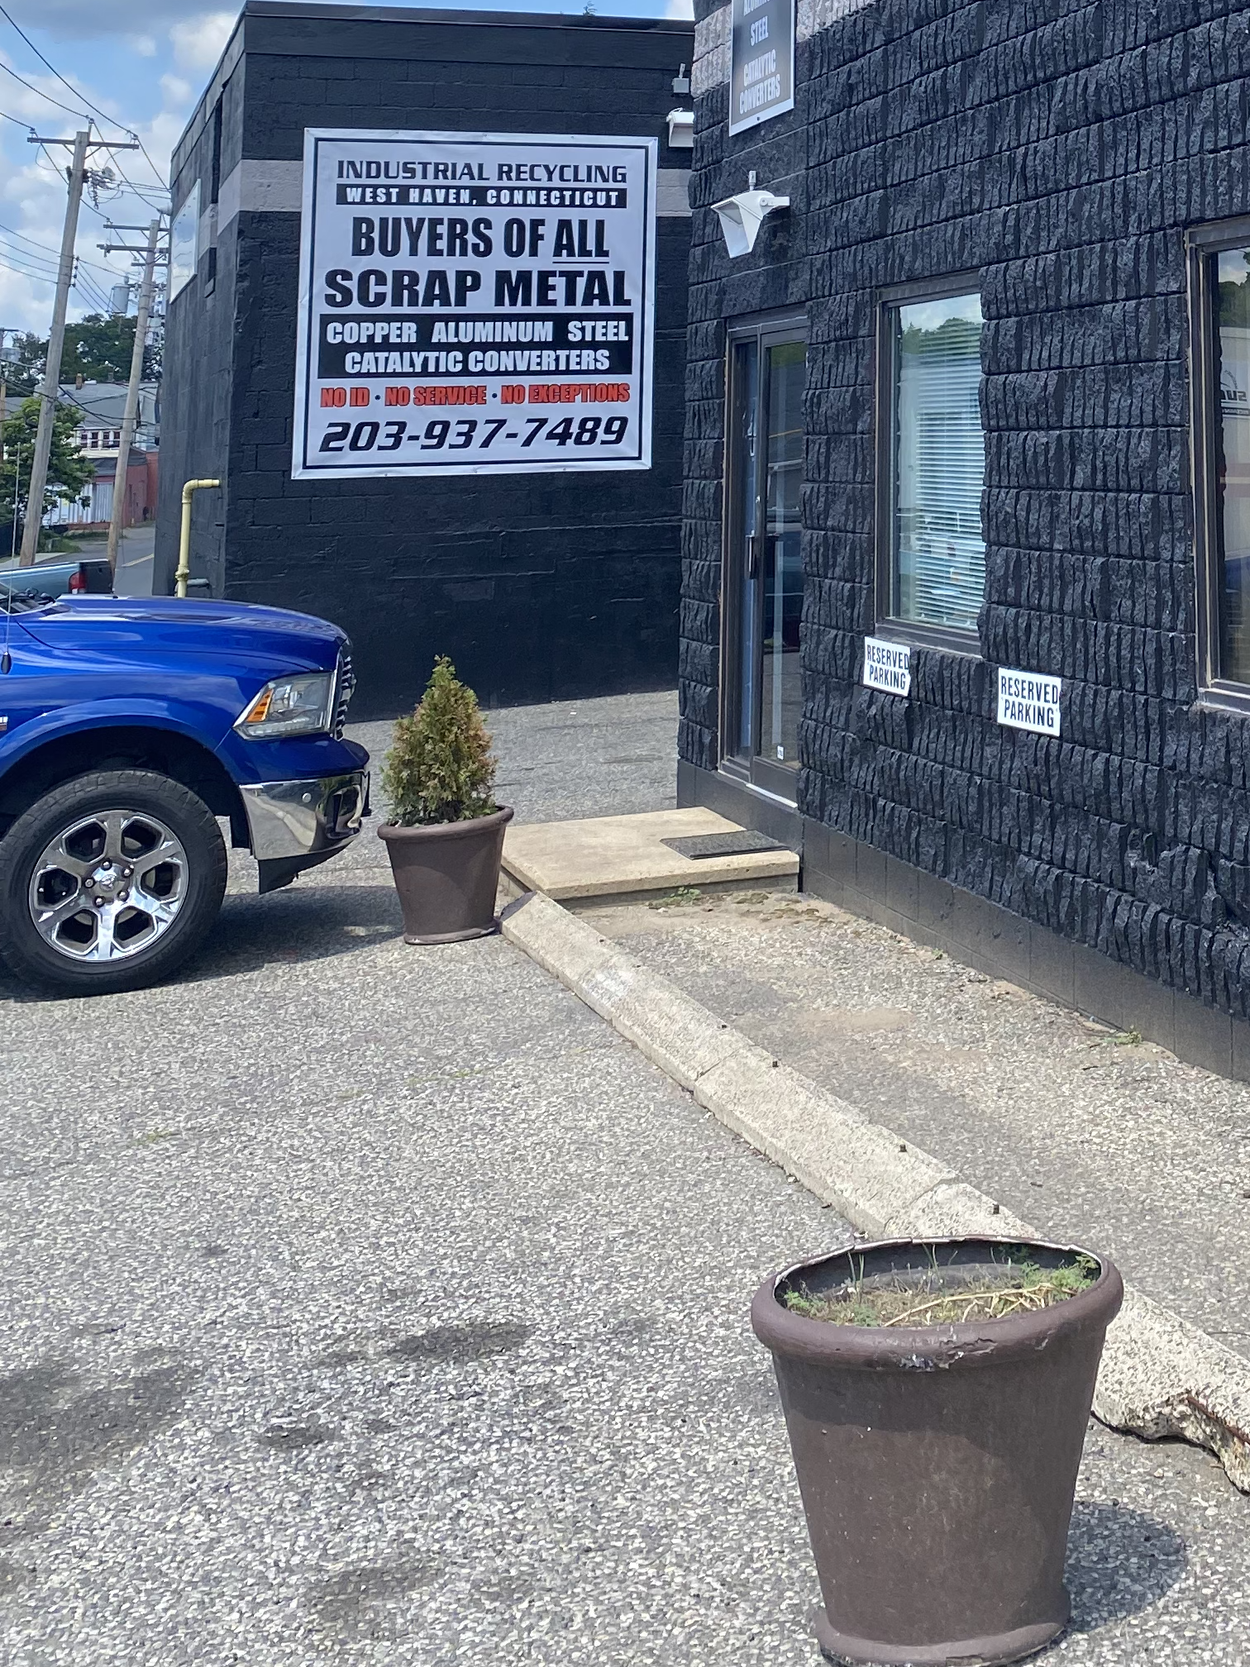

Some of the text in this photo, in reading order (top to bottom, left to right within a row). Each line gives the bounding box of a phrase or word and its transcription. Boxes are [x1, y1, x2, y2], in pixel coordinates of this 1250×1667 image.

[750, 16, 769, 48] STEEL
[743, 48, 776, 87] CATALYTIC
[739, 74, 780, 115] CONVERTERS
[337, 160, 627, 183] INDUSTRIAL RECYCLING
[346, 188, 618, 206] WEST HAVEN, CONNECTICUT
[352, 217, 609, 258] BUYERS OF ALL
[324, 269, 632, 307] SCRAP METAL
[326, 321, 628, 343] COPPER ALUMINUM STEEL
[345, 350, 609, 374] CATALYTIC CONVERTERS
[321, 383, 630, 407] NO ID NO SERVICE NO EXCEPTIONS
[319, 416, 629, 452] 203-937-7489
[867, 645, 909, 670] RESERVED
[869, 666, 906, 690] PARKING
[1001, 676, 1058, 704] RESERVED
[1004, 699, 1054, 728] PARKING
